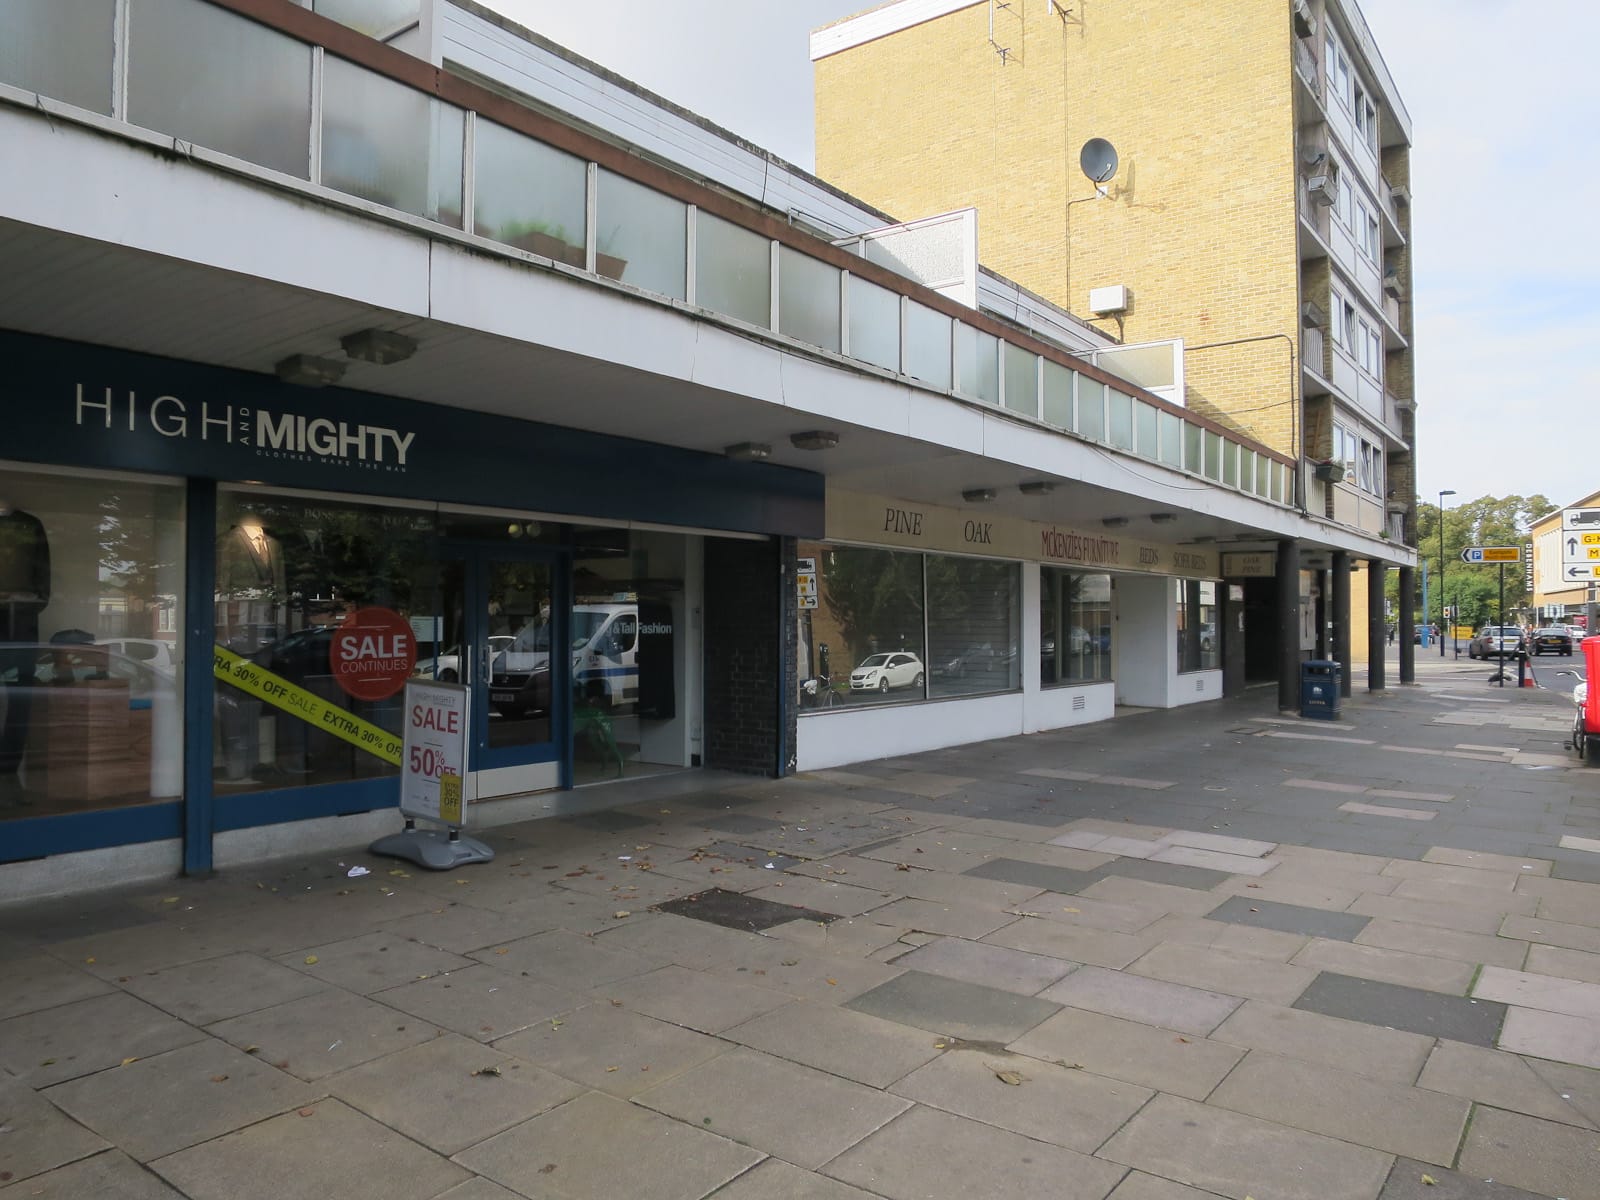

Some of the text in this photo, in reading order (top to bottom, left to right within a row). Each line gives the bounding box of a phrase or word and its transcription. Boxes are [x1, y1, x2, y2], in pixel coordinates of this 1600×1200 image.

[75, 383, 416, 465] HIGH AND MIGHTY
[256, 449, 313, 462] CLOTHES
[359, 462, 378, 472] THE
[386, 465, 407, 473] MAN
[883, 507, 923, 536] PINE
[964, 519, 993, 545] OAK
[1589, 549, 1599, 558] M
[1525, 543, 1534, 592] DEBENHAMS
[620, 621, 635, 634] Tall
[637, 622, 672, 634] Fashion
[340, 634, 408, 661] SALE
[340, 659, 408, 673] CONTINUES
[233, 665, 259, 687] 30%
[262, 680, 289, 699] OFF
[287, 692, 319, 716] SALE
[322, 709, 360, 738] EXTRA
[360, 729, 384, 750] 30%
[385, 742, 402, 759] OF
[411, 704, 459, 735] SALE
[409, 745, 446, 777] 50%
[434, 764, 457, 779] OFF
[443, 797, 459, 808] OFF
